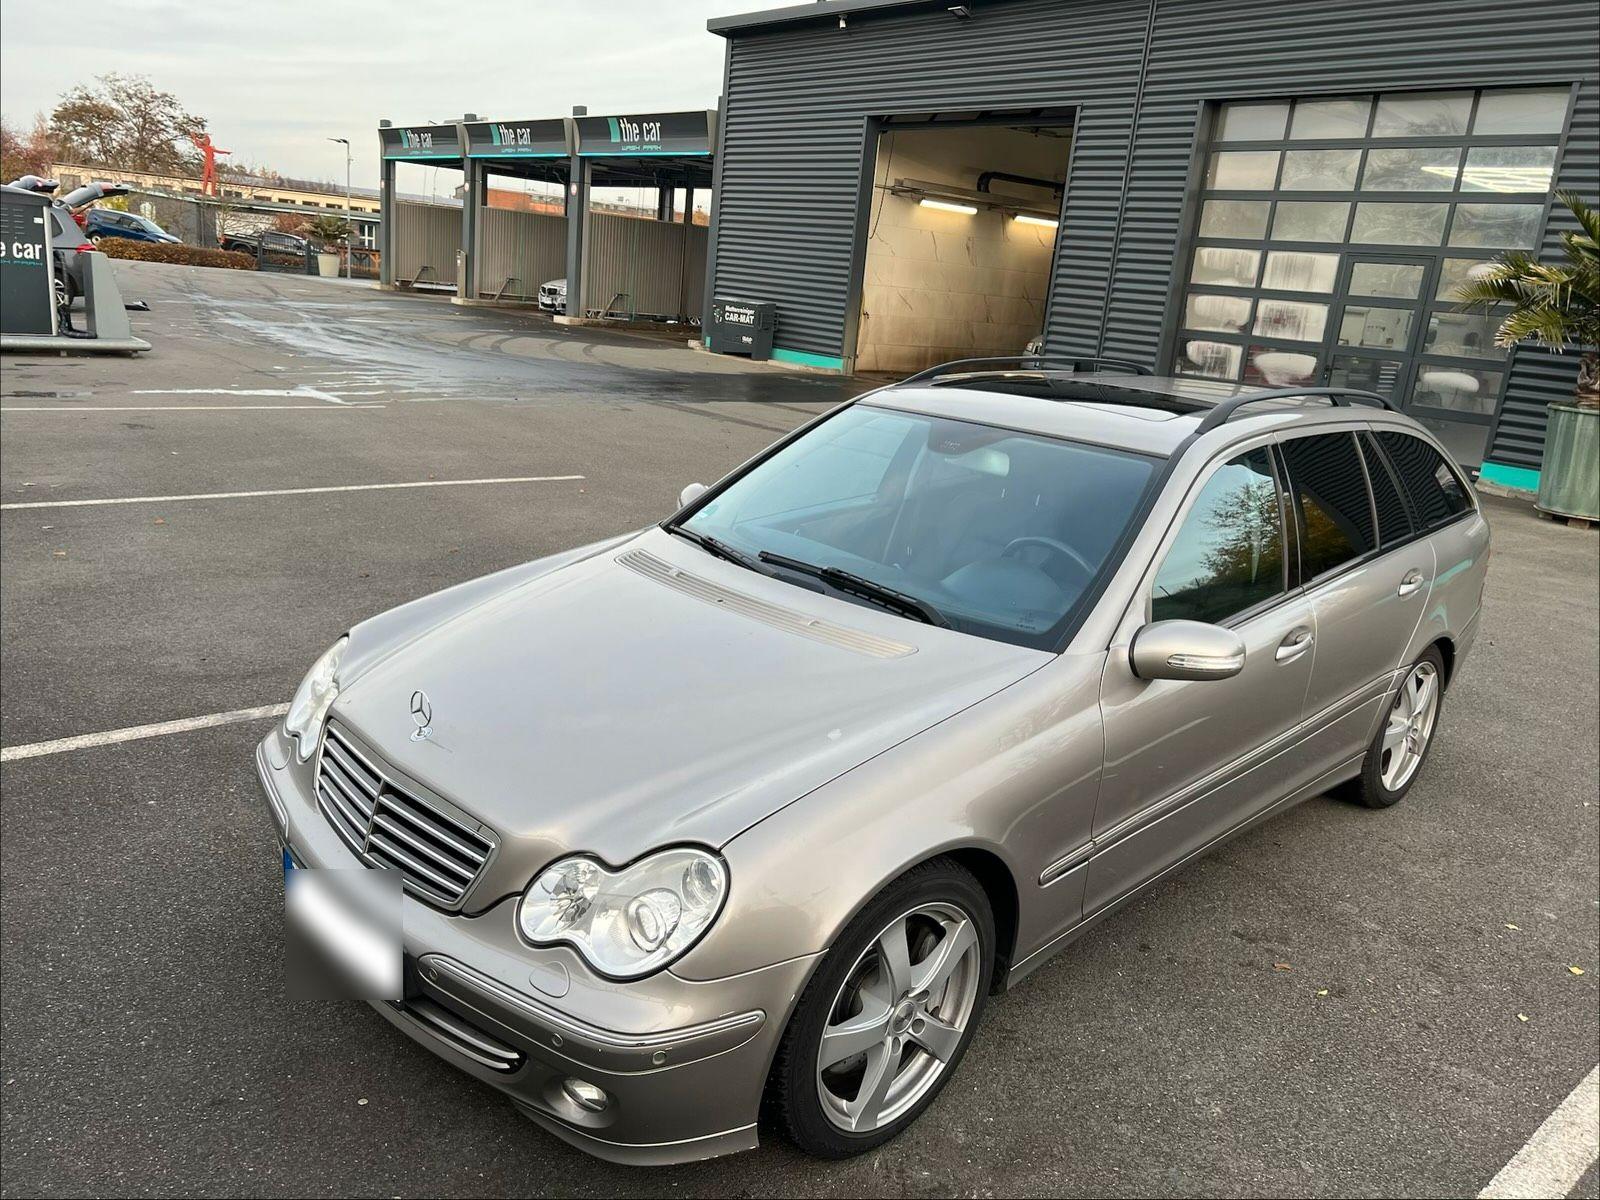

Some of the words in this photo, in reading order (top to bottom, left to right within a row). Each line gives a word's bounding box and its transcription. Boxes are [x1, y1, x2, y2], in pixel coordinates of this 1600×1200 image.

[406, 129, 420, 148] the
[421, 132, 433, 148] car
[499, 124, 515, 145] the
[517, 128, 531, 145] car
[619, 117, 640, 142] the
[642, 122, 661, 142] car
[12, 241, 43, 260] car
[724, 312, 755, 325] CAR-MAT
